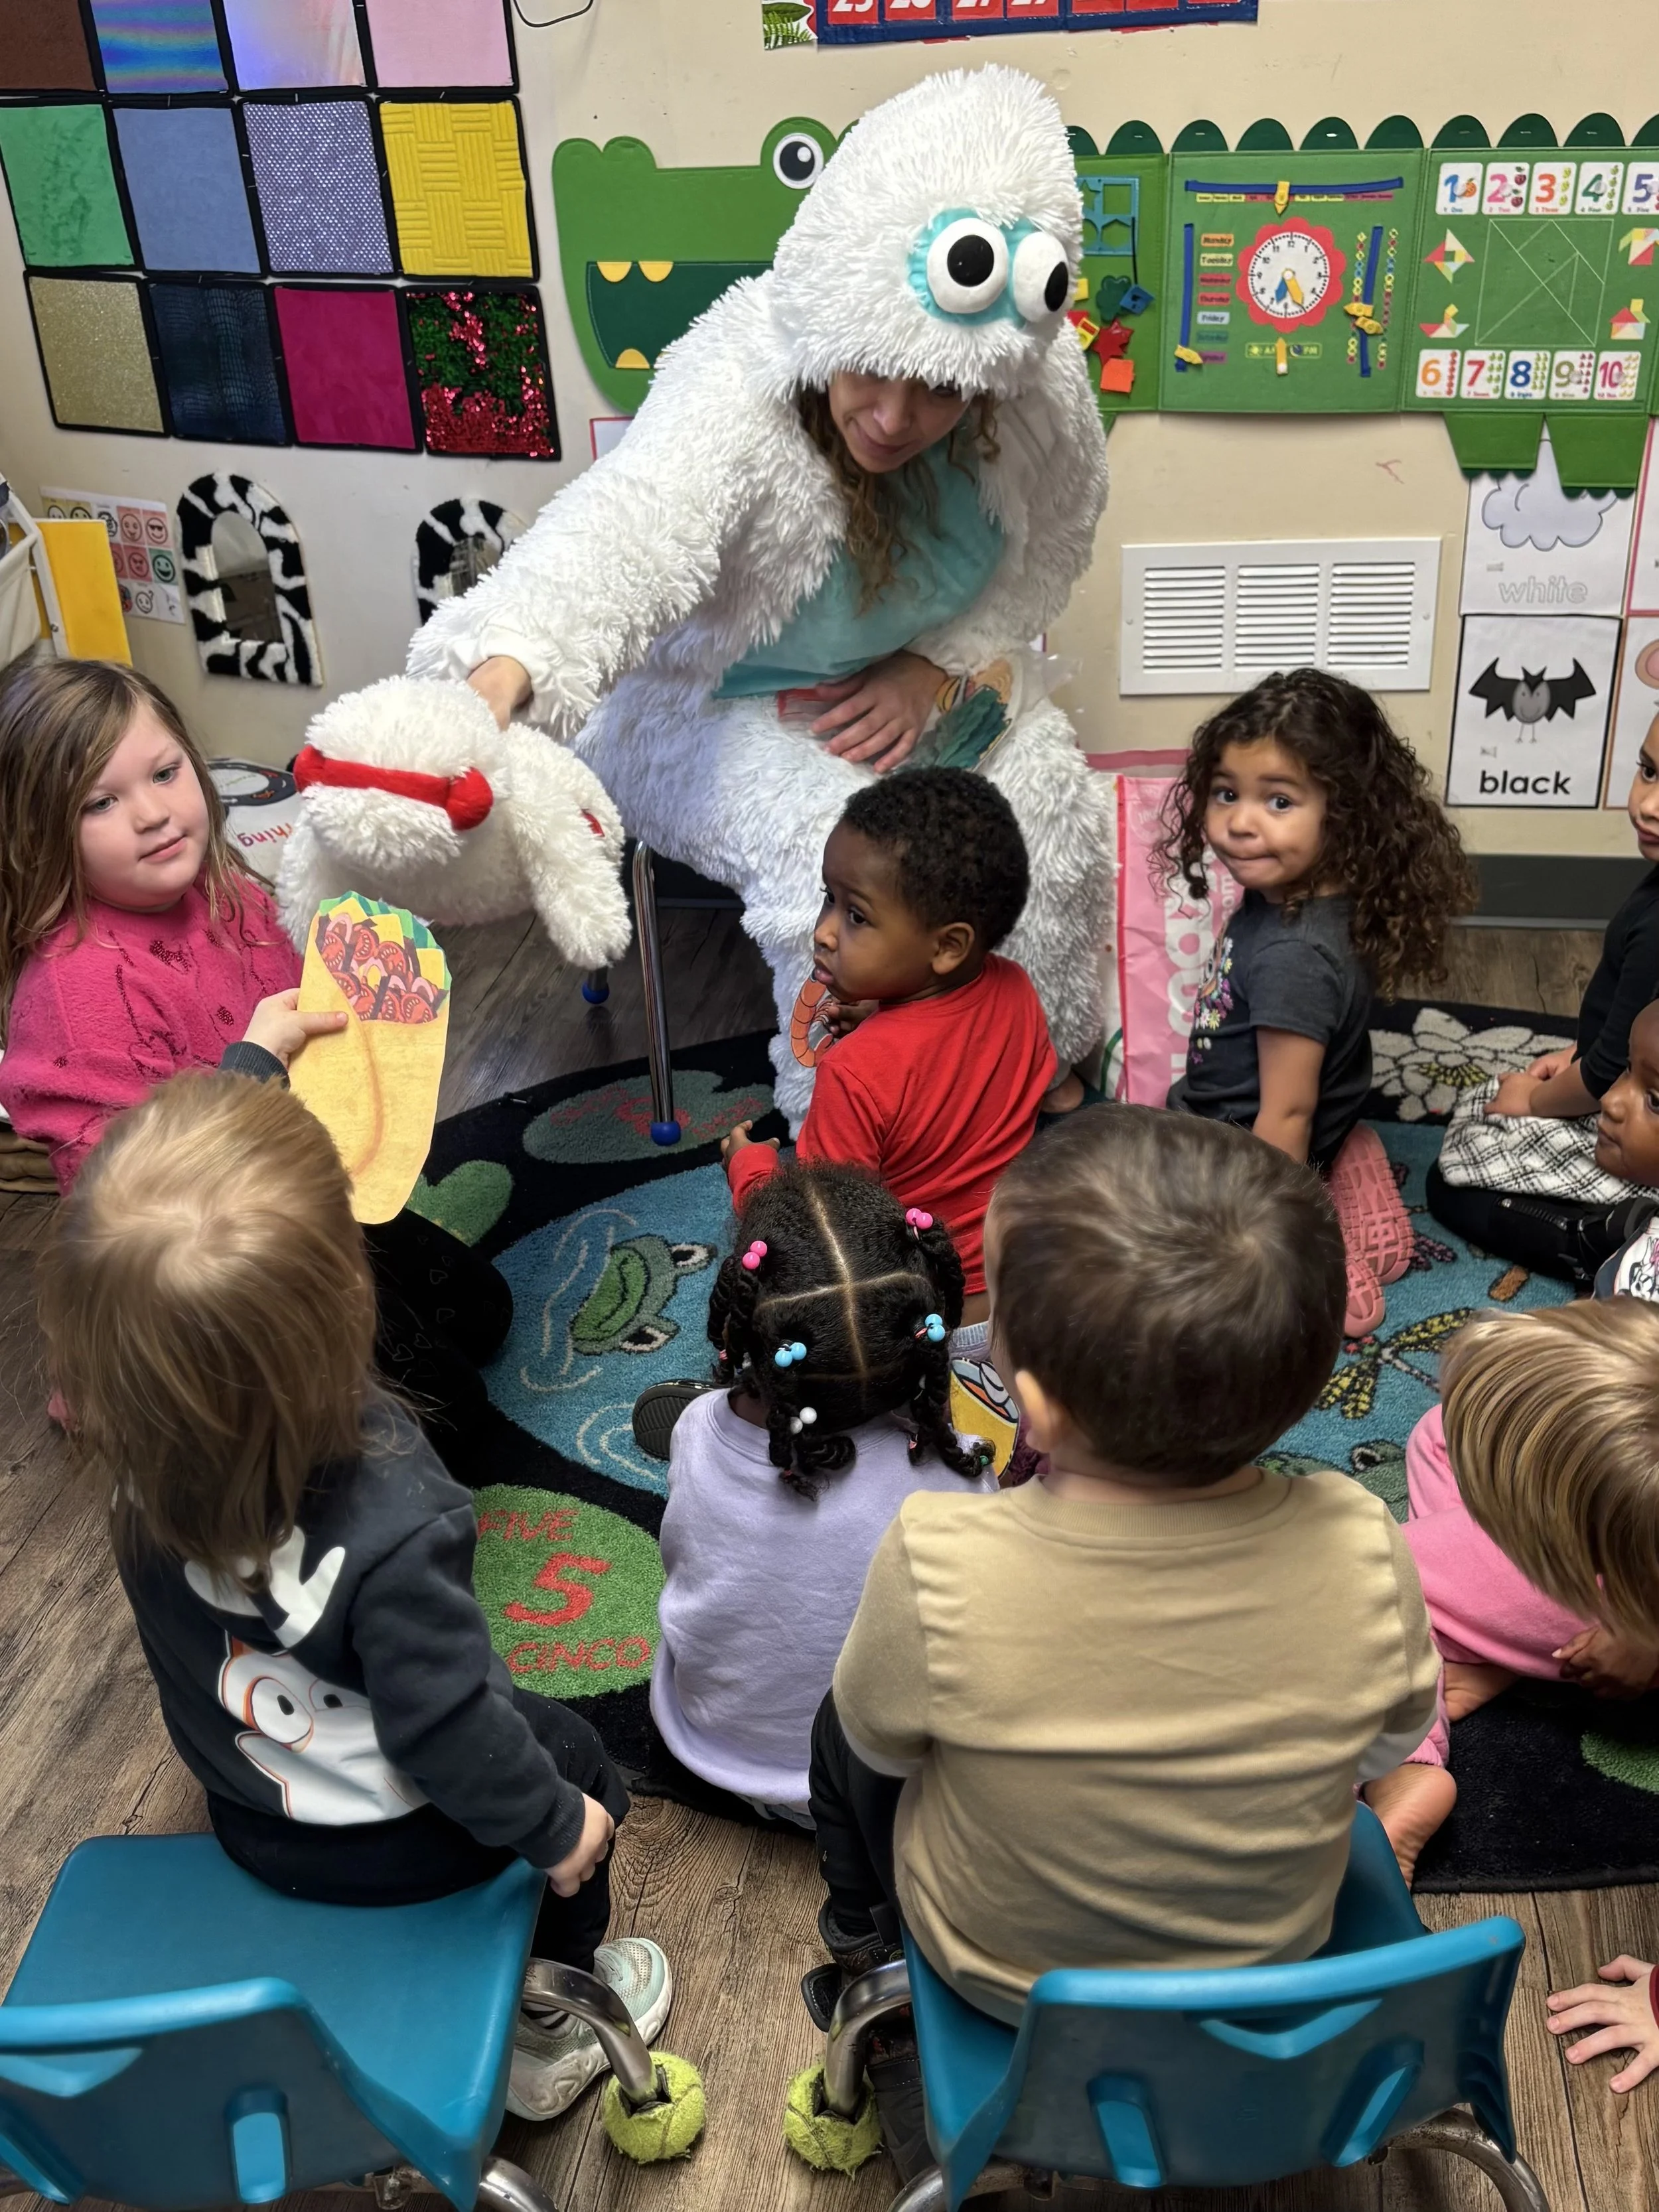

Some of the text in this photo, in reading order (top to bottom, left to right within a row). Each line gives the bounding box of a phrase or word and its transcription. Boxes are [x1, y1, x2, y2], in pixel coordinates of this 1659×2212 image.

[1444, 174, 1459, 203] 1
[1486, 174, 1508, 203] 2
[1535, 173, 1556, 203] 3
[1581, 173, 1605, 202] 4
[1632, 173, 1654, 203] 5
[1421, 358, 1441, 387] 6
[1467, 359, 1486, 387] 7
[1510, 360, 1532, 388] 8
[1555, 360, 1575, 388] 9
[1599, 360, 1624, 389] 10
[1498, 575, 1588, 604] white
[1479, 770, 1571, 795] black
[477, 1508, 579, 1541] FIVE
[502, 1552, 612, 1627] 5
[507, 1635, 651, 1673] CINCO
